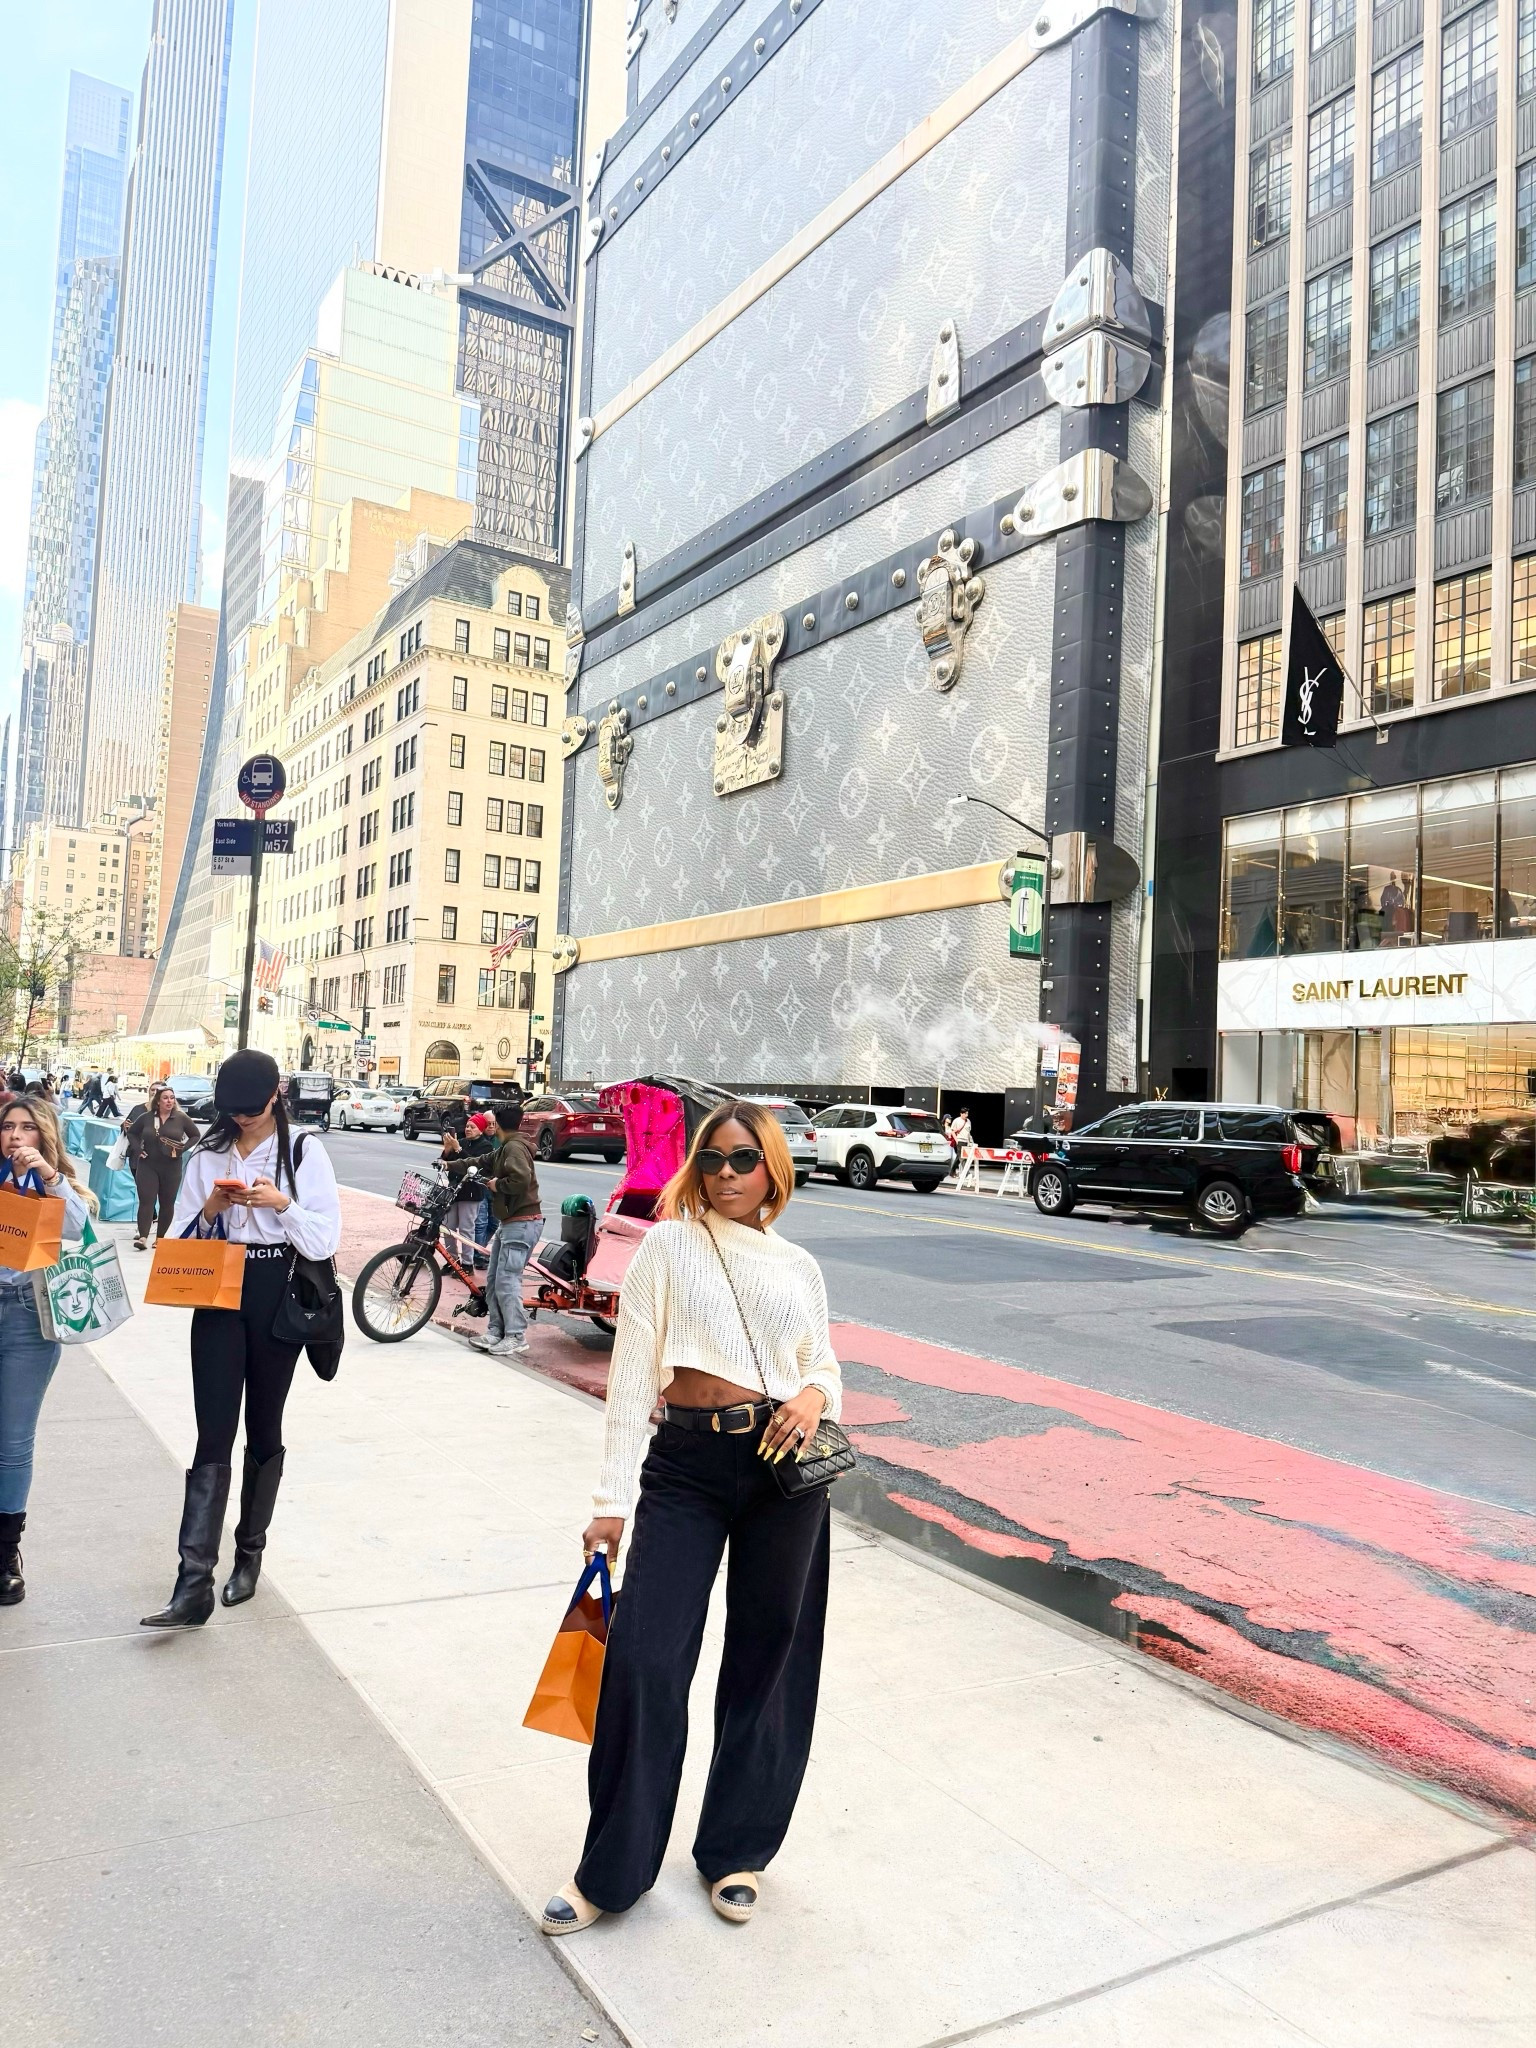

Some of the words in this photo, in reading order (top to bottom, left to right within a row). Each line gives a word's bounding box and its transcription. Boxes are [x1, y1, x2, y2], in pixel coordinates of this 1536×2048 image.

[241, 793, 251, 804] NO
[250, 792, 281, 809] STANDING
[265, 822, 289, 835] M31
[264, 839, 289, 852] M57
[1292, 979, 1354, 1003] SAINT
[1358, 973, 1469, 998] LAURENT
[157, 1266, 181, 1275] LOUIS
[182, 1267, 215, 1276] VUITTON
